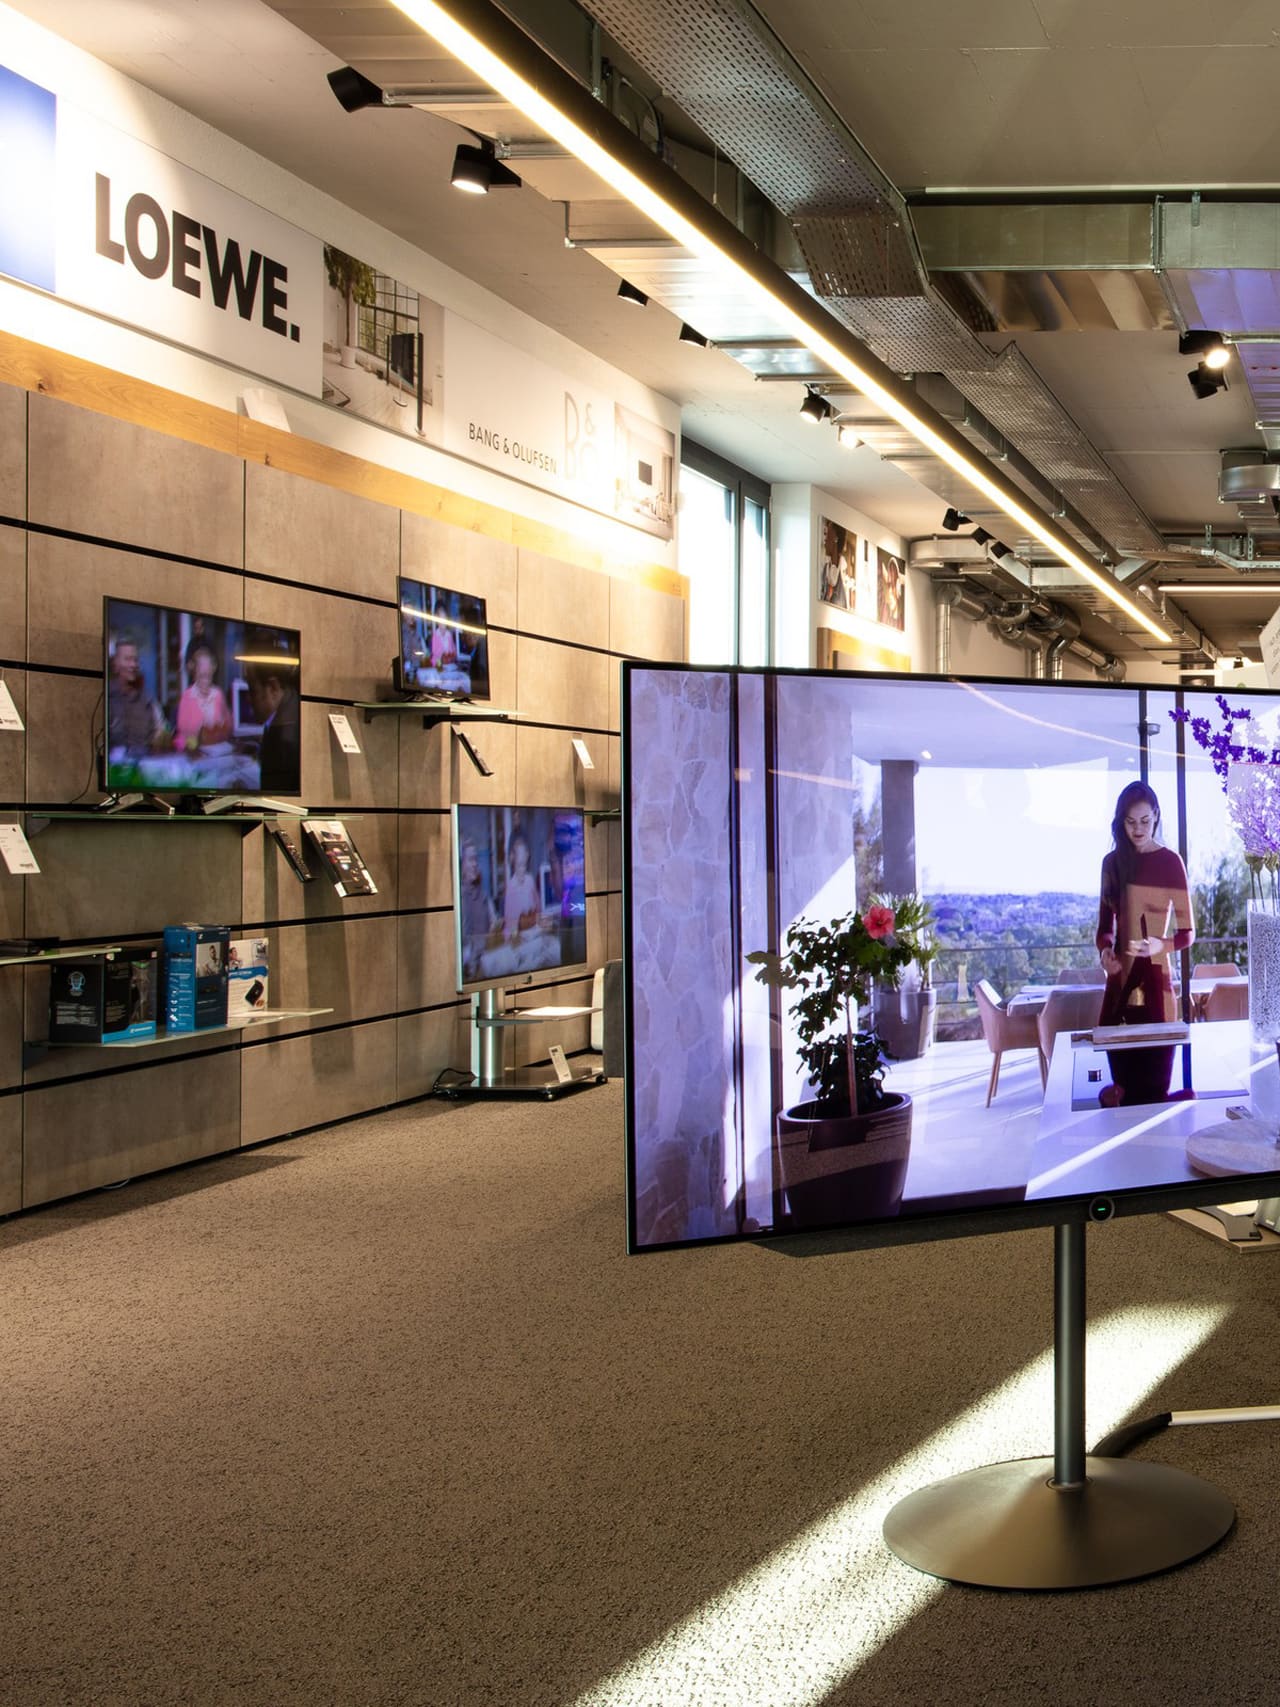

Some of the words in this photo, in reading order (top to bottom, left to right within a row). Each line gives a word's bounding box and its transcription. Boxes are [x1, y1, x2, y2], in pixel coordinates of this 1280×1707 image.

[95, 171, 300, 344] LOEWE.
[469, 422, 500, 450] BANG
[503, 437, 510, 454] &
[512, 442, 558, 475] OLUFSEN
